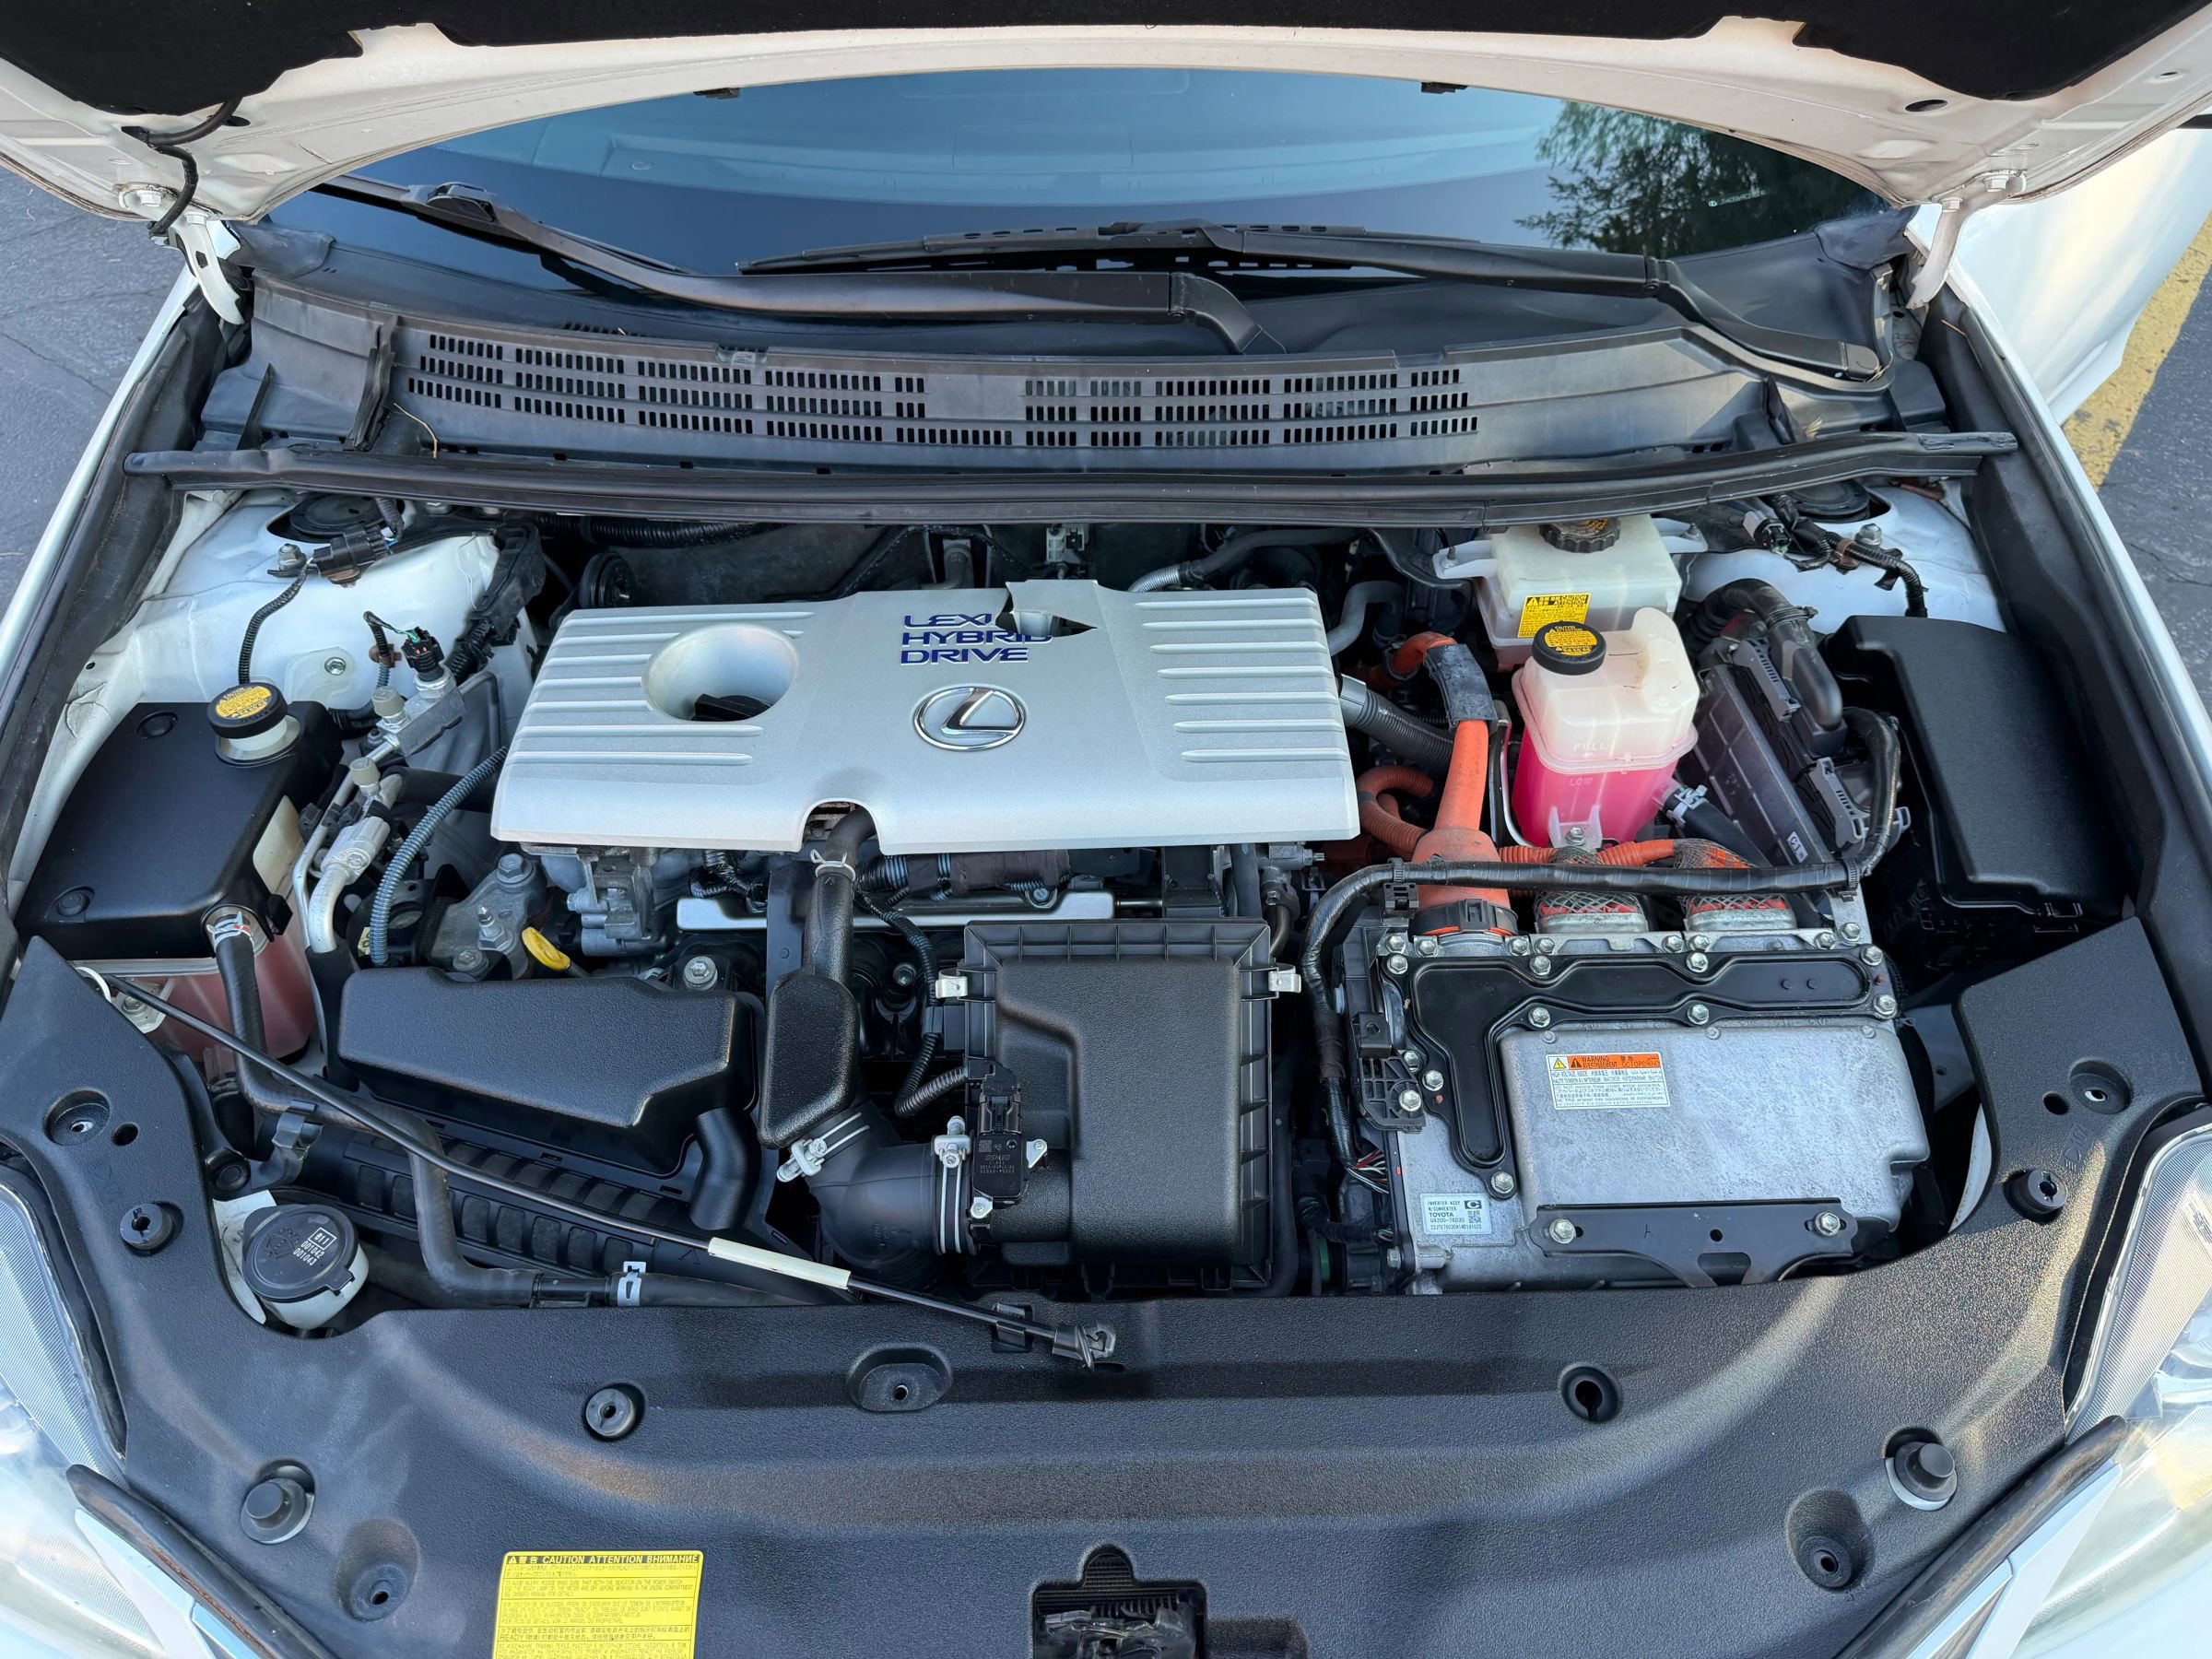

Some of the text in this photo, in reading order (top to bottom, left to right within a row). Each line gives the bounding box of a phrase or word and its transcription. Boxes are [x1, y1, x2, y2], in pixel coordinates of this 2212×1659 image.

[905, 614, 993, 629] LEX
[901, 648, 1029, 665] DRIVE
[1572, 741, 1606, 752] FULL
[1569, 778, 1593, 786] LOW
[293, 1248, 317, 1265] 001043
[300, 1241, 324, 1258] 001042
[647, 1555, 698, 1563] ВНИМАНИЕ
